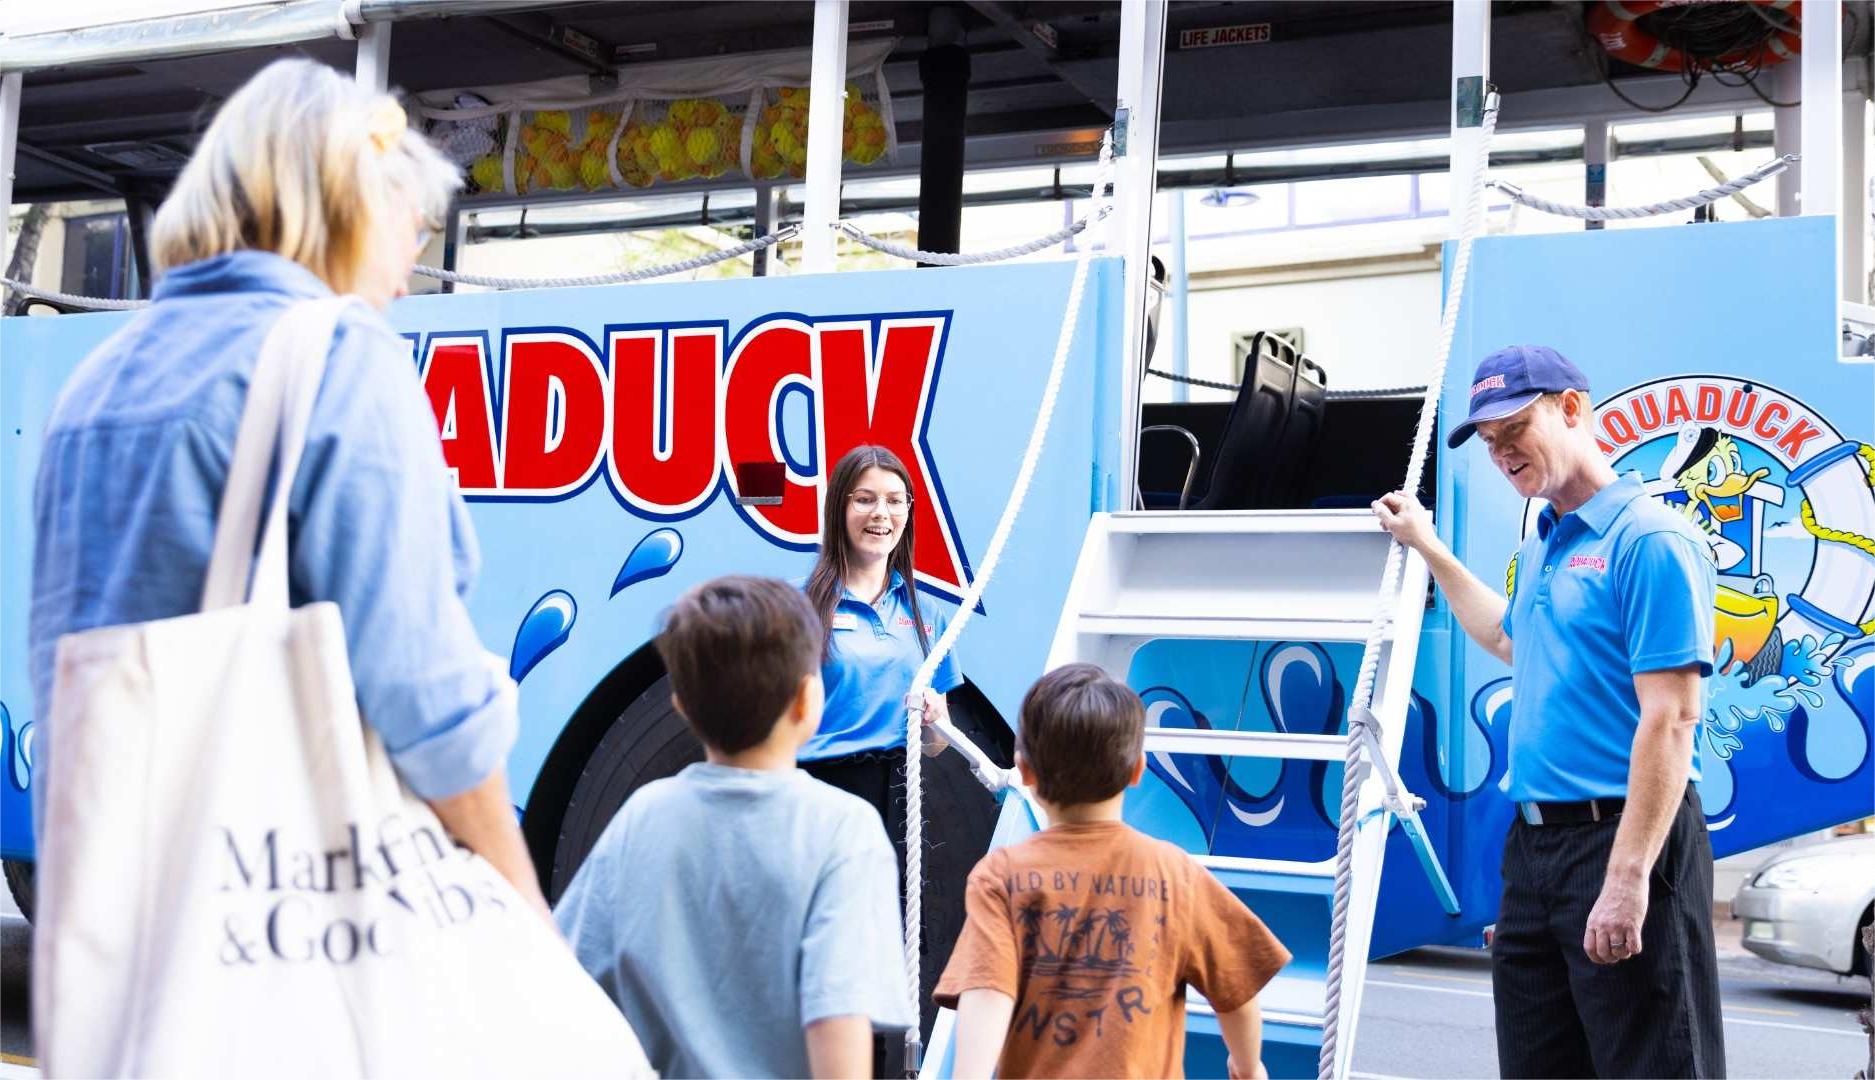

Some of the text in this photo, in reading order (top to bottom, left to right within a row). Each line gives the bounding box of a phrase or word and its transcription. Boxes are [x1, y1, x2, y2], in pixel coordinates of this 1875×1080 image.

[1182, 25, 1269, 46] LIFE JACKETS
[403, 310, 985, 615] ADUCK
[1054, 871, 1080, 892] BY
[1091, 873, 1169, 902] NATURE
[1013, 985, 1152, 1047] NSTR
